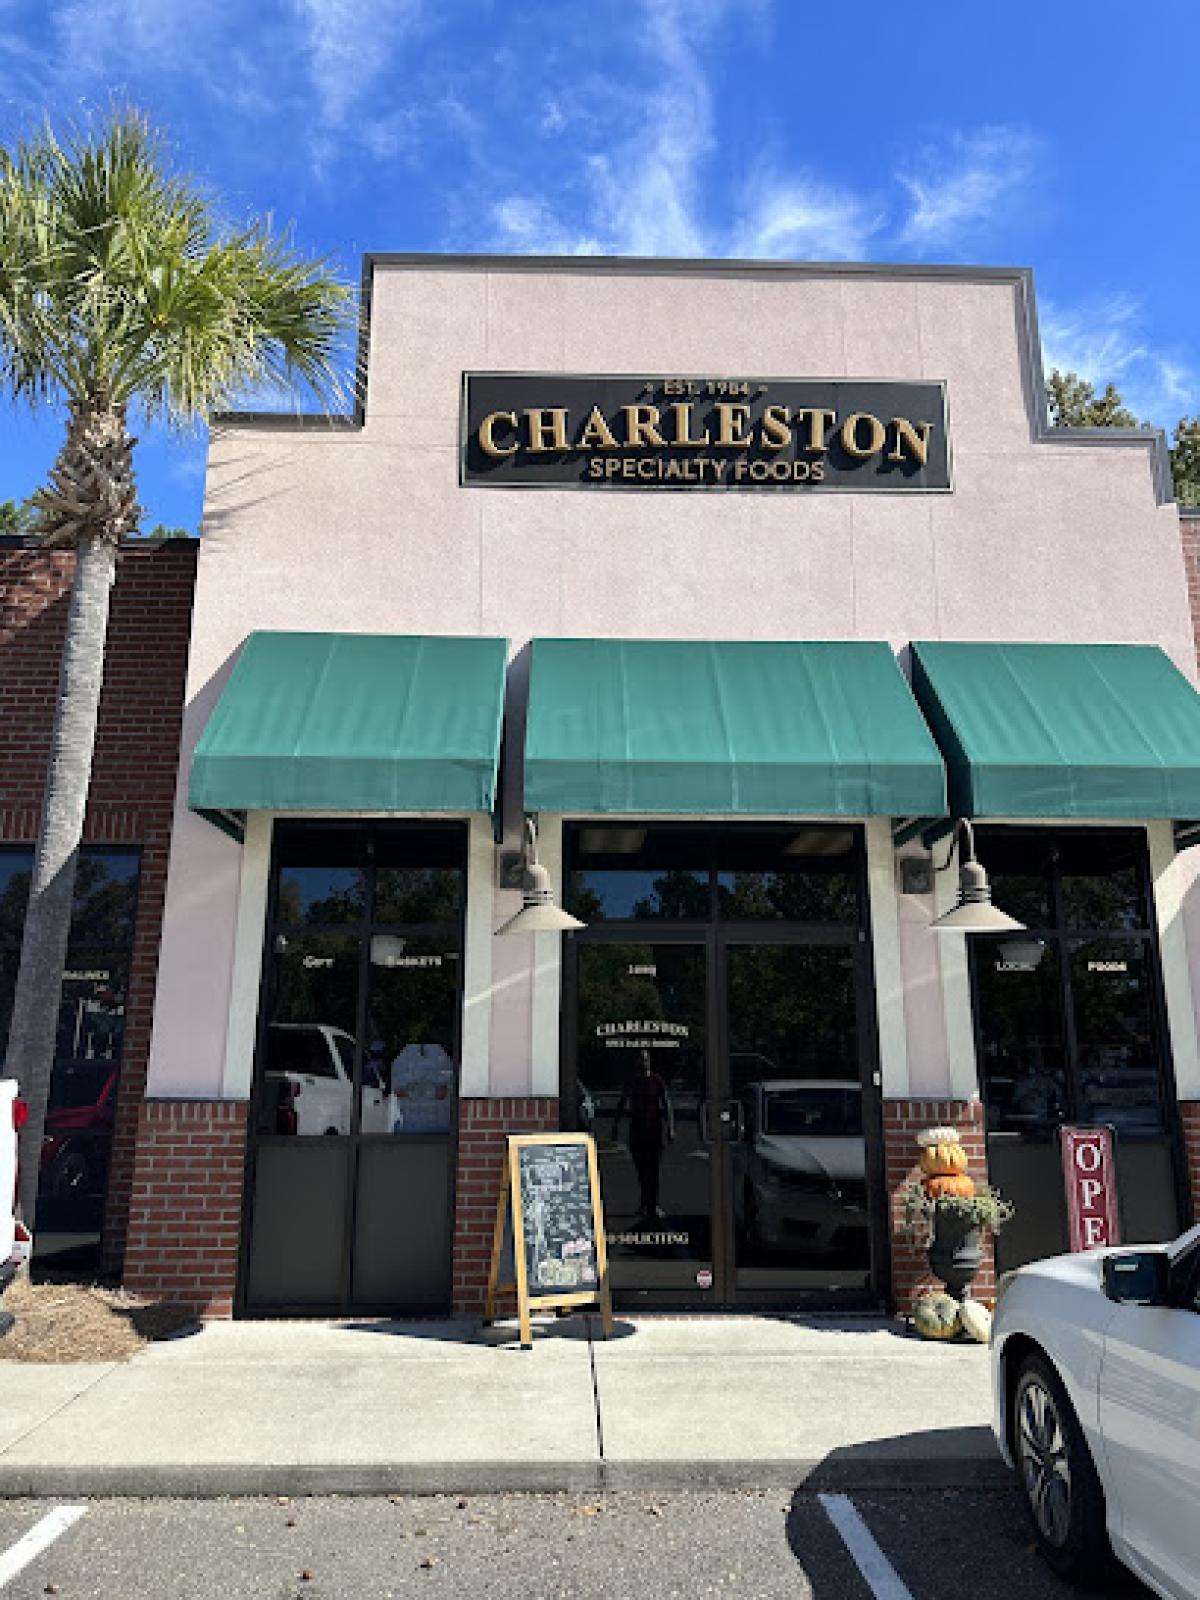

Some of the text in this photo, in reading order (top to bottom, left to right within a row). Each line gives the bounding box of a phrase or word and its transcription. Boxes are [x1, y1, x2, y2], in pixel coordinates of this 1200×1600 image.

[478, 402, 934, 466] CHARLESTON
[590, 457, 826, 481] SPECIALTY FOODS
[1075, 1143, 1107, 1248] OPE
